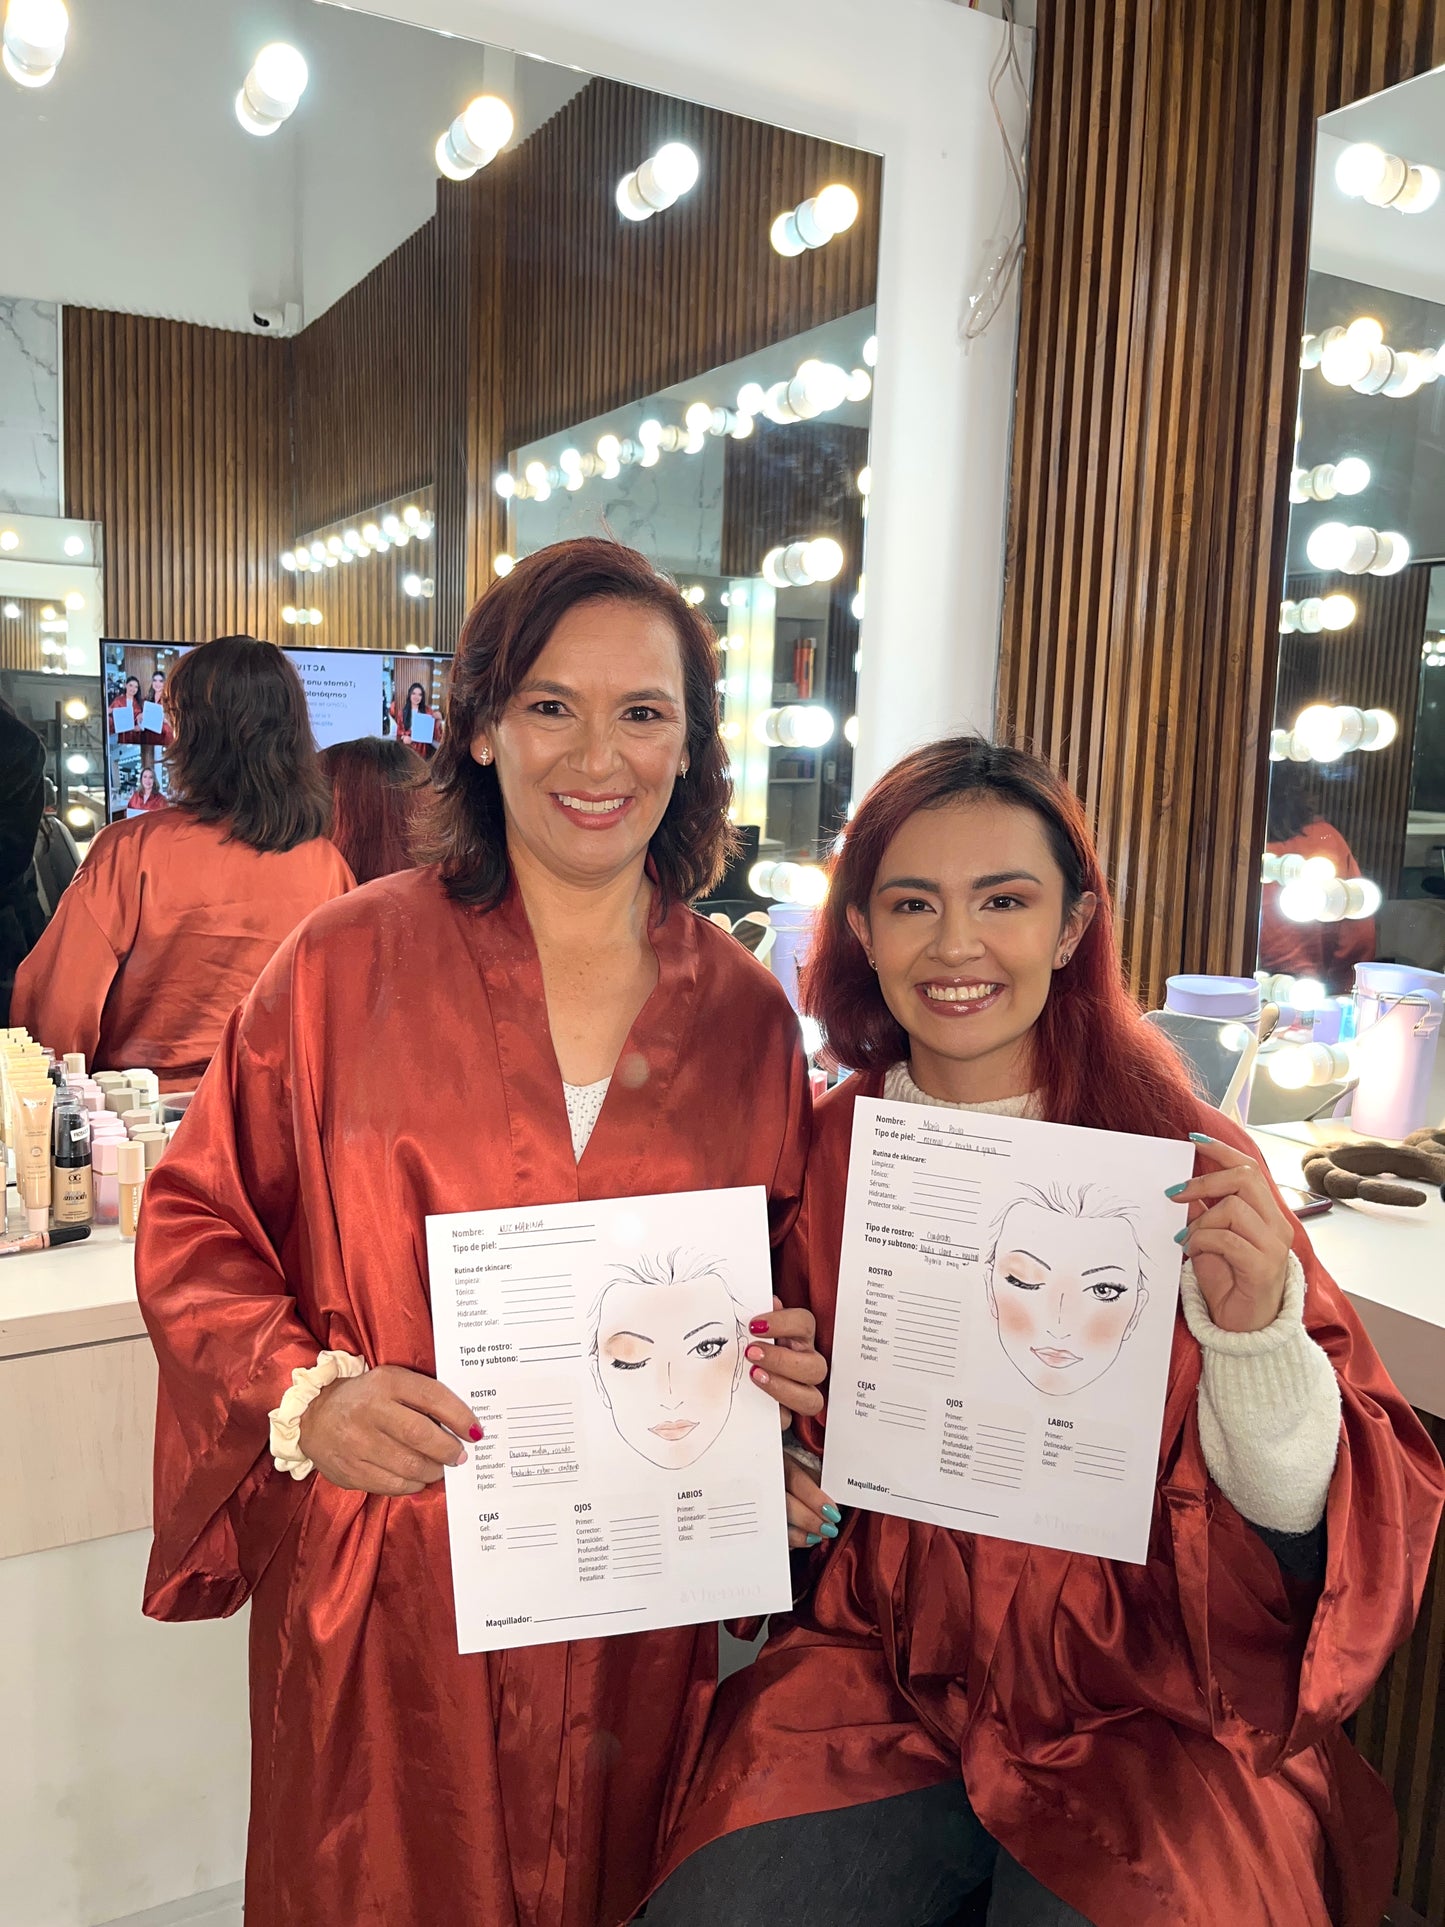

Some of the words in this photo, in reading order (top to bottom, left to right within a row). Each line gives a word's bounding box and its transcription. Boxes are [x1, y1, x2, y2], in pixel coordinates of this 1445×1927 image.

[876, 1115, 906, 1126] Nombre:
[874, 1128, 890, 1139] Tipo
[891, 1130, 900, 1139] de
[900, 1131, 916, 1142] piel:
[872, 1150, 891, 1160] Rutina
[892, 1152, 899, 1160] de
[900, 1153, 927, 1164] skincare:
[871, 1160, 895, 1169] Limpieza:
[870, 1169, 889, 1178] Tónico:
[869, 1179, 891, 1189] Sérums:
[868, 1189, 898, 1200] Hidratante:
[867, 1199, 891, 1209] Protector
[892, 1203, 907, 1212] solar:
[452, 1228, 484, 1238] Nombre:
[866, 1222, 880, 1232] Tipo
[881, 1225, 890, 1234] de
[891, 1227, 915, 1238] rostro:
[453, 1244, 469, 1254] Tipo
[470, 1242, 480, 1251] de
[481, 1241, 497, 1252] piel:
[864, 1234, 882, 1244] Tono
[882, 1237, 887, 1246] y
[887, 1238, 918, 1251] subtono:
[454, 1266, 475, 1274] Rutina
[475, 1265, 484, 1273] de
[485, 1263, 513, 1272] skincare:
[868, 1266, 893, 1277] ROSTRO
[454, 1277, 480, 1286] Limpieza:
[867, 1280, 884, 1289] Primer:
[455, 1288, 475, 1296] Tónico:
[866, 1290, 895, 1300] Correctores:
[456, 1299, 479, 1307] Sérums:
[865, 1299, 878, 1307] Base:
[457, 1309, 488, 1318] Hidratante:
[864, 1308, 888, 1317] Contorno:
[458, 1320, 483, 1329] Protector
[484, 1318, 500, 1327] solar:
[863, 1317, 884, 1326] Bronzer:
[863, 1326, 879, 1334] Rubor:
[862, 1335, 889, 1345] Iluminador:
[459, 1345, 476, 1356] Tipo
[477, 1343, 487, 1353] de
[488, 1342, 513, 1352] rostro:
[861, 1344, 878, 1352] Polvos:
[460, 1358, 479, 1367] Tono
[479, 1358, 485, 1367] y
[486, 1354, 519, 1365] subtono:
[860, 1353, 879, 1362] Fijador:
[857, 1380, 876, 1391] CEJAS
[470, 1388, 497, 1398] ROSTRO
[856, 1400, 877, 1410] Pomada:
[946, 1398, 964, 1408] OJOS
[945, 1412, 964, 1421] Primer:
[944, 1421, 968, 1431] Corrector:
[1047, 1417, 1074, 1429] LABIOS
[943, 1431, 969, 1441] Transición:
[1045, 1431, 1064, 1440] Primer:
[474, 1444, 496, 1452] Bronzer:
[942, 1440, 974, 1451] Profundidad:
[1044, 1440, 1073, 1451] Delineador:
[475, 1453, 493, 1461] Rubor:
[941, 1449, 971, 1460] Iluminación:
[1043, 1450, 1059, 1458] Labial:
[476, 1462, 506, 1471] Iluminador:
[940, 1458, 969, 1468] Delineador:
[1042, 1459, 1057, 1468] Gloss:
[476, 1473, 495, 1481] Polvos:
[940, 1467, 964, 1477] Pestañina:
[477, 1482, 497, 1492] Fijador:
[847, 1478, 890, 1494] Maquillador:
[677, 1489, 703, 1500] LABIOS
[574, 1503, 592, 1513] OJOS
[677, 1505, 695, 1513] Primer:
[478, 1512, 500, 1522] CEJAS
[575, 1518, 594, 1526] Primer:
[677, 1514, 706, 1523] Delineador:
[576, 1527, 601, 1535] Corrector:
[678, 1524, 694, 1532] Labial:
[577, 1536, 604, 1544] Transición:
[577, 1545, 610, 1554] Profundidad:
[578, 1555, 609, 1564] Iluminación:
[578, 1564, 608, 1573] Delineador:
[579, 1573, 605, 1582] Pestañina:
[485, 1615, 533, 1628] Maquillador:
